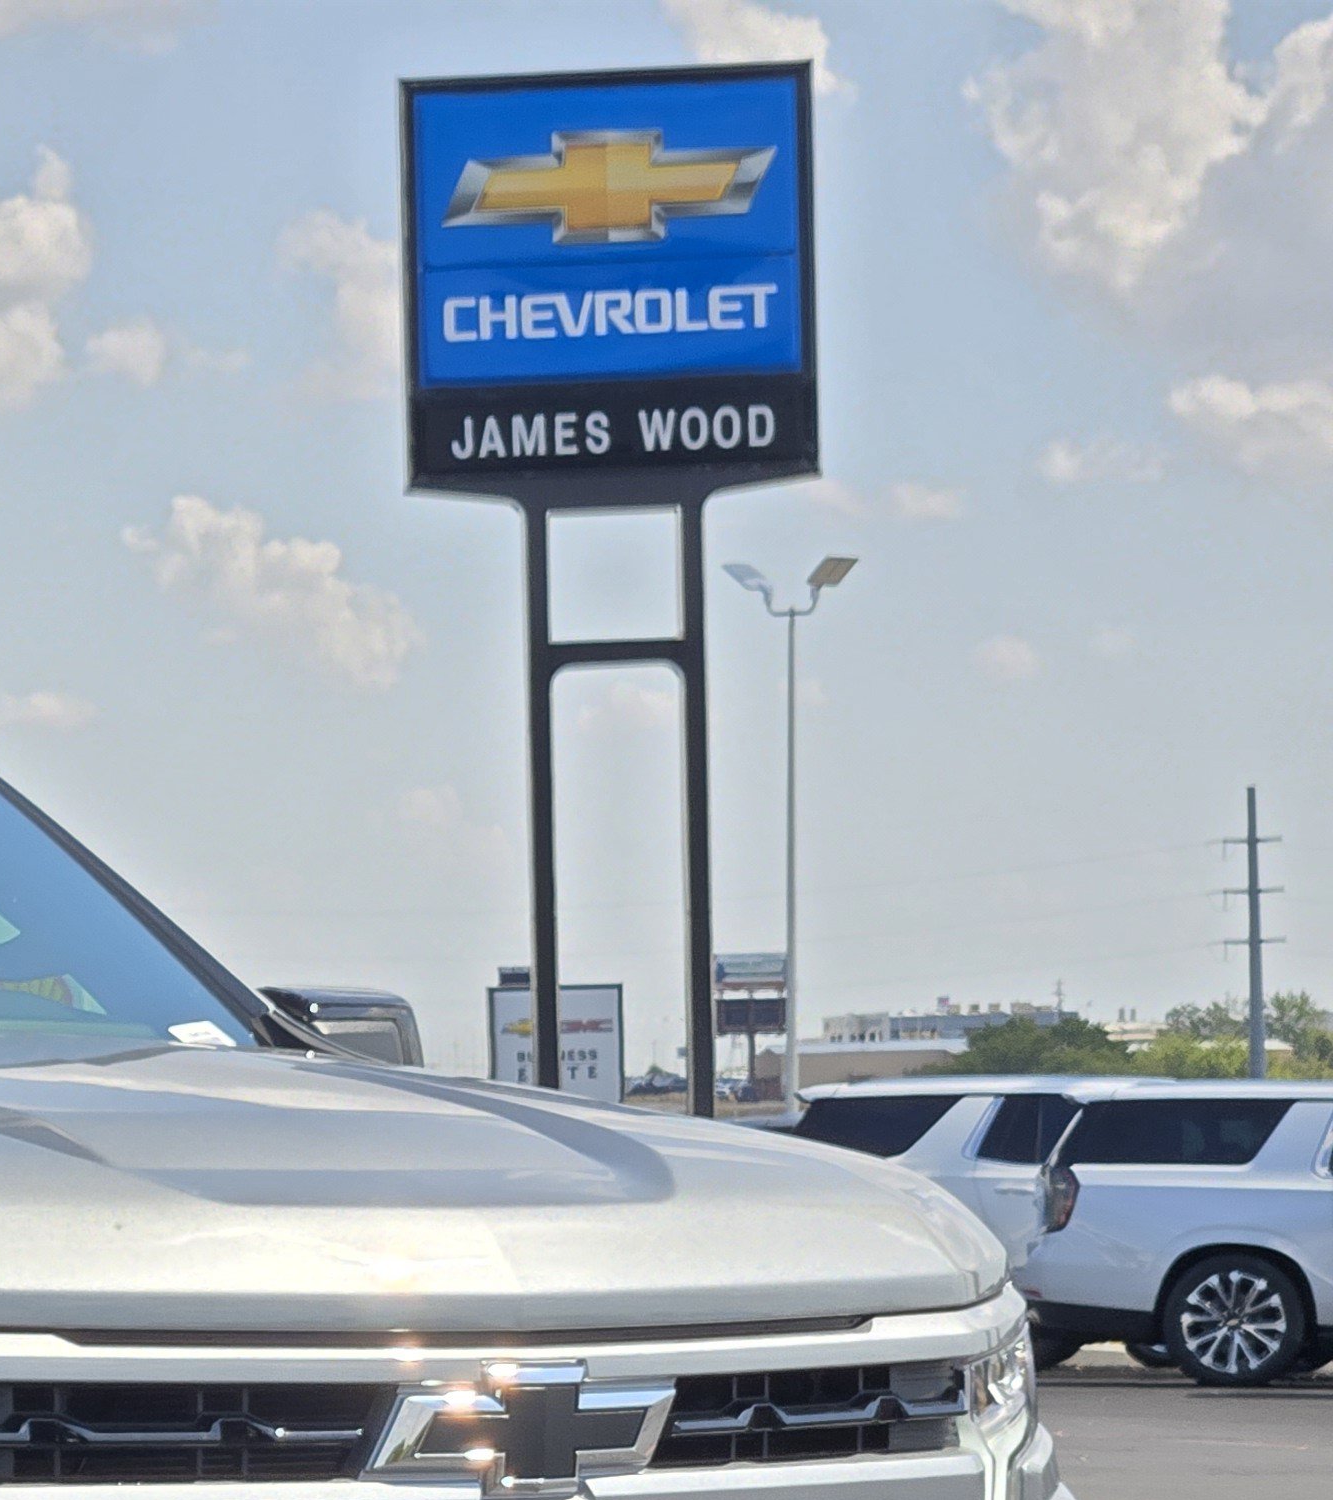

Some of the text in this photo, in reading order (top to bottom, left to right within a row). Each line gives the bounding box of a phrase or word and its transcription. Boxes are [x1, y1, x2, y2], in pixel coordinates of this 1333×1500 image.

[442, 283, 779, 343] CHEVROLET
[450, 404, 777, 461] JAMES WOOD
